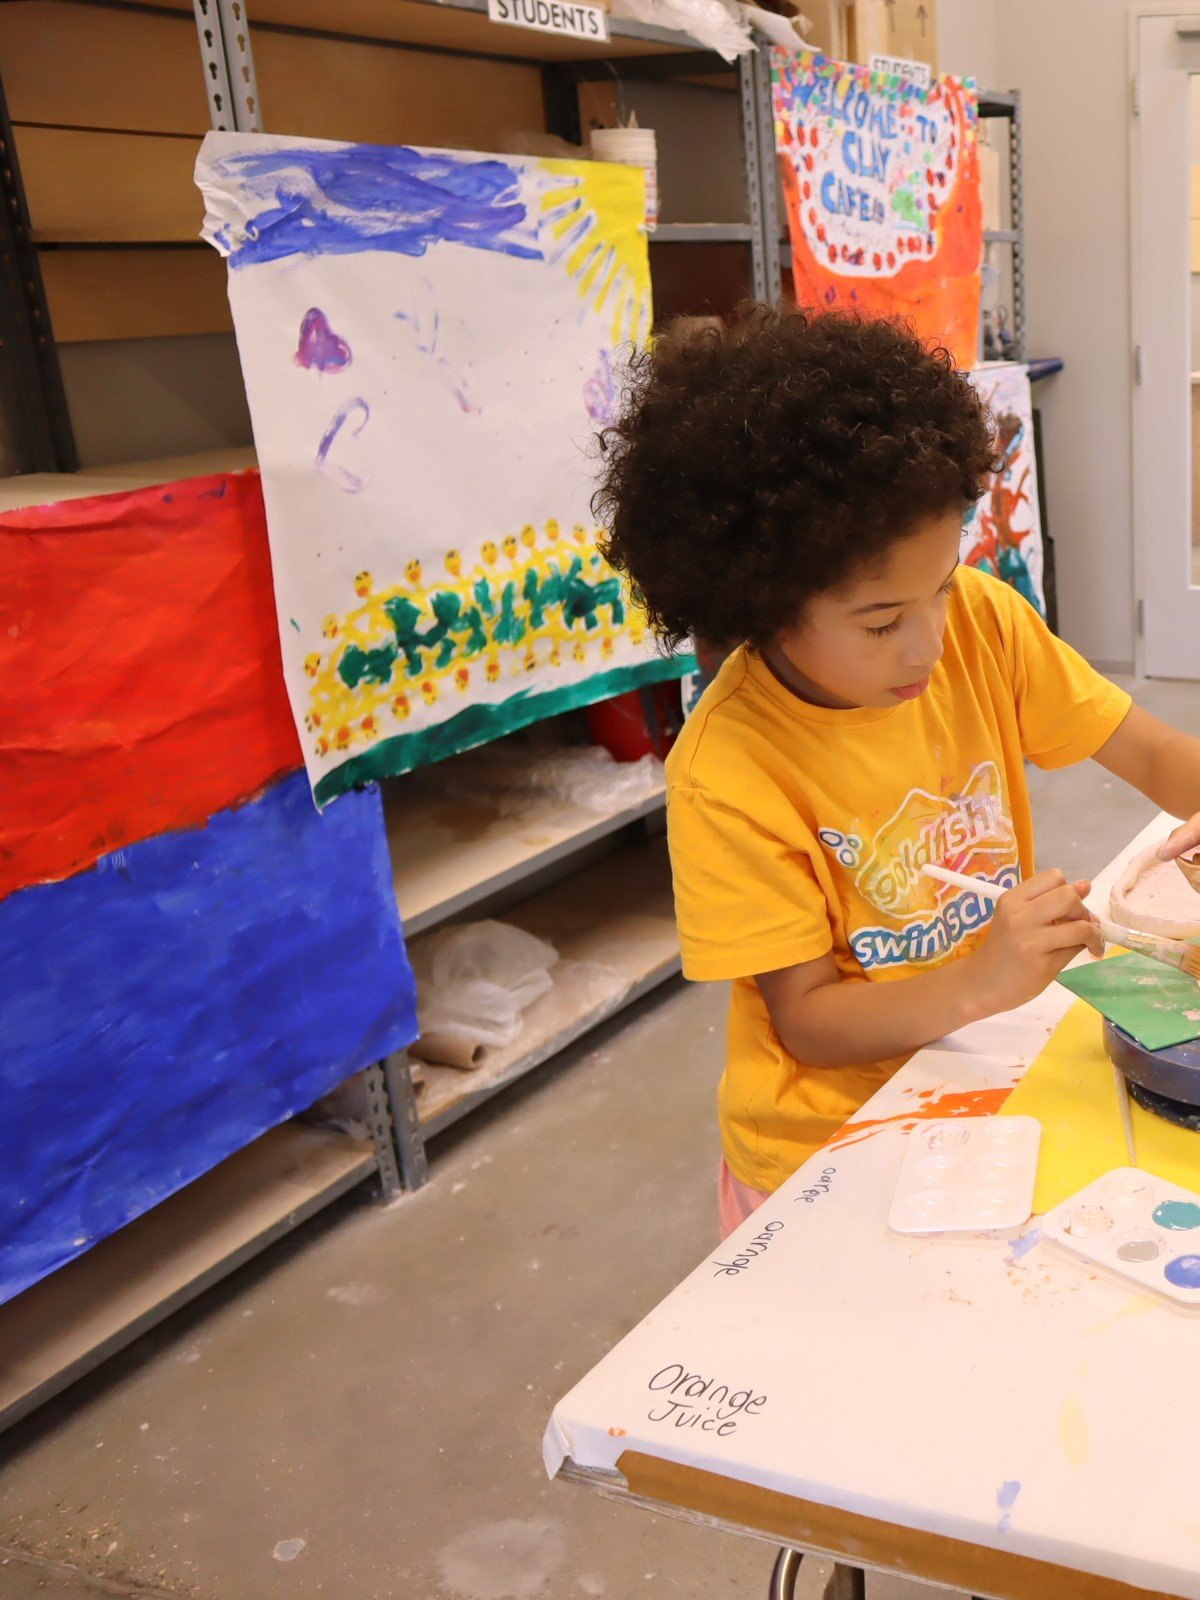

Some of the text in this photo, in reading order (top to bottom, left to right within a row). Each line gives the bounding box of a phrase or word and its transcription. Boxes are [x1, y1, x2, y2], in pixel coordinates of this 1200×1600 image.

[498, 0, 598, 34] STUDENTS
[916, 114, 939, 144] TO
[841, 131, 891, 184] CLAY
[648, 1364, 767, 1420] Orange
[648, 1400, 738, 1436] Juice
